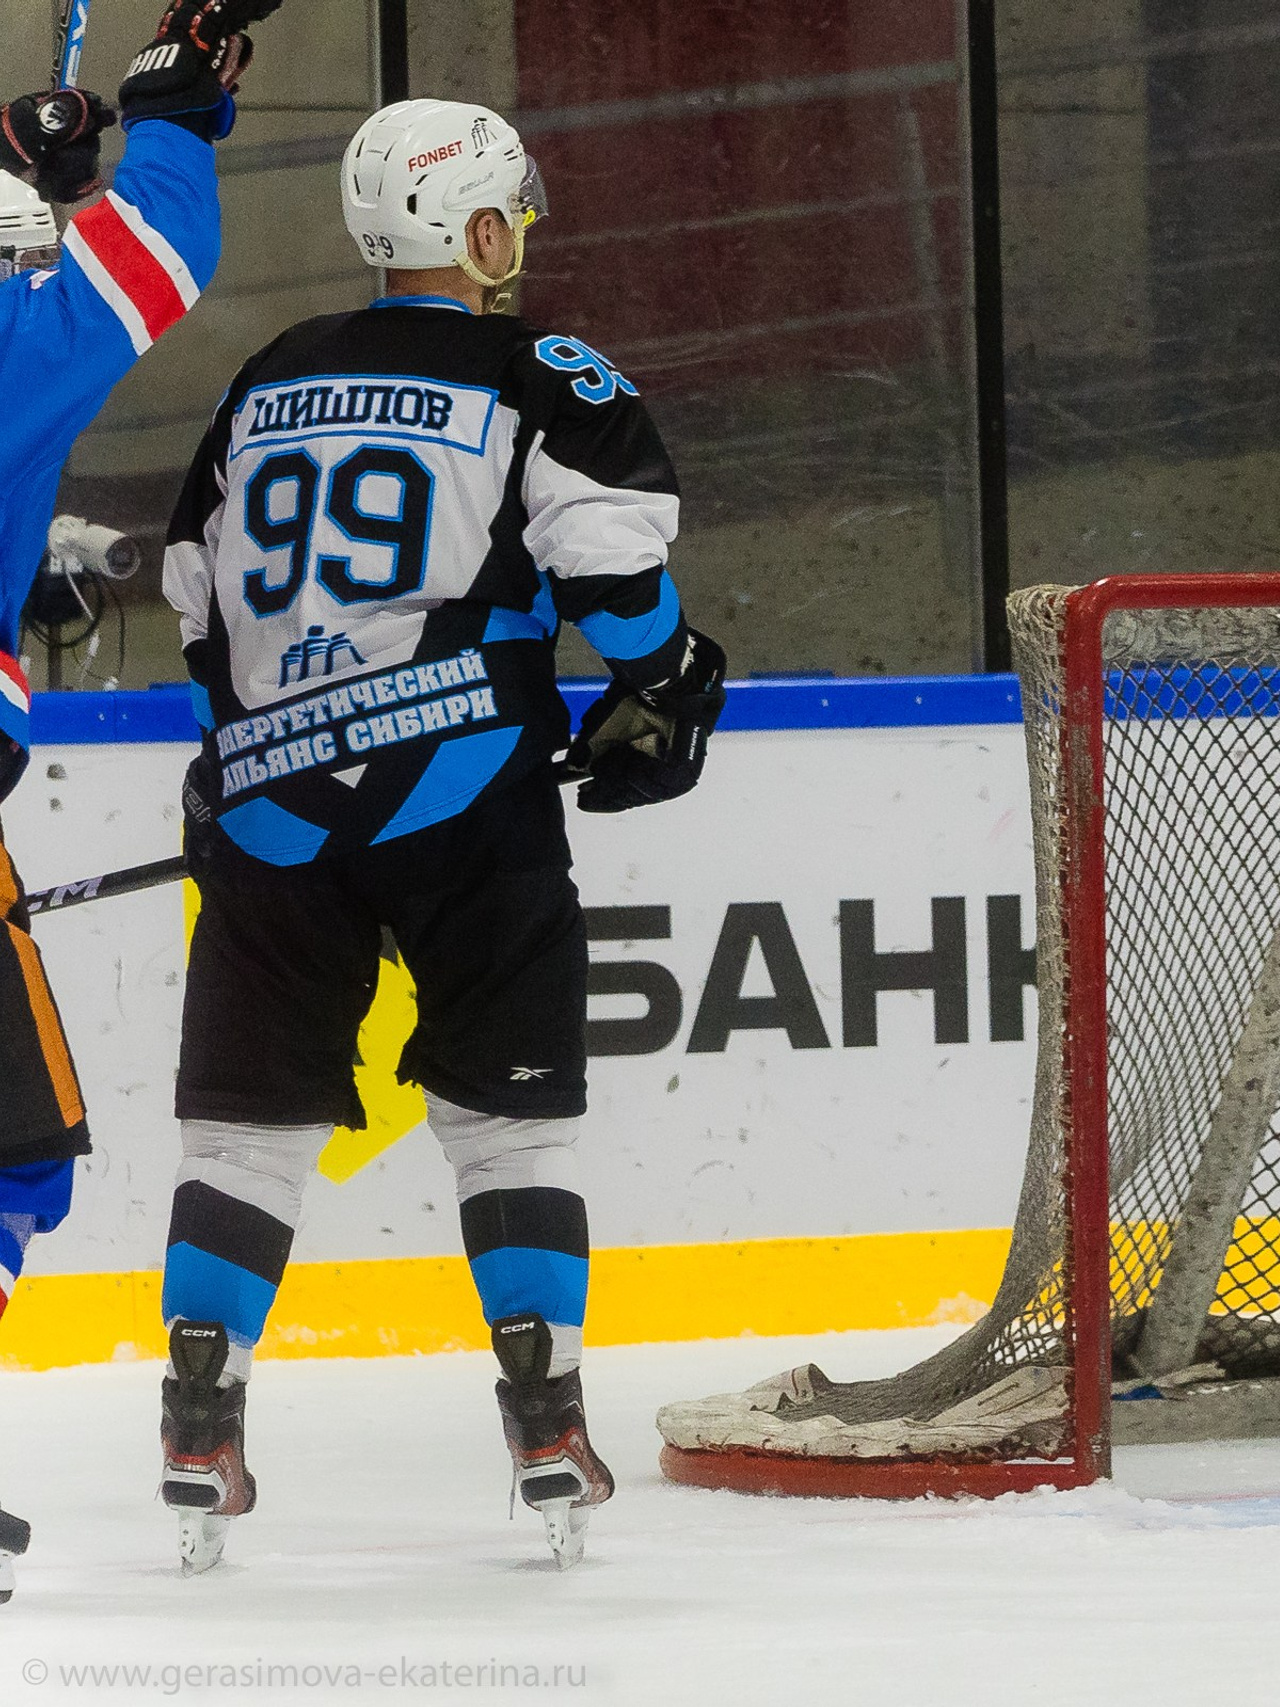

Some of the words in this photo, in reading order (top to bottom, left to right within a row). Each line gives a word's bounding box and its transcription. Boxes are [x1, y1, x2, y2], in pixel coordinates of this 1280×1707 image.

[408, 140, 463, 172] FONBET
[362, 233, 394, 260] 99
[248, 385, 453, 436] ШИШЛОВ
[243, 443, 437, 620] 99
[345, 685, 498, 754] СИБИРИ
[181, 1328, 217, 1338] CCM
[501, 1321, 535, 1334] CCM
